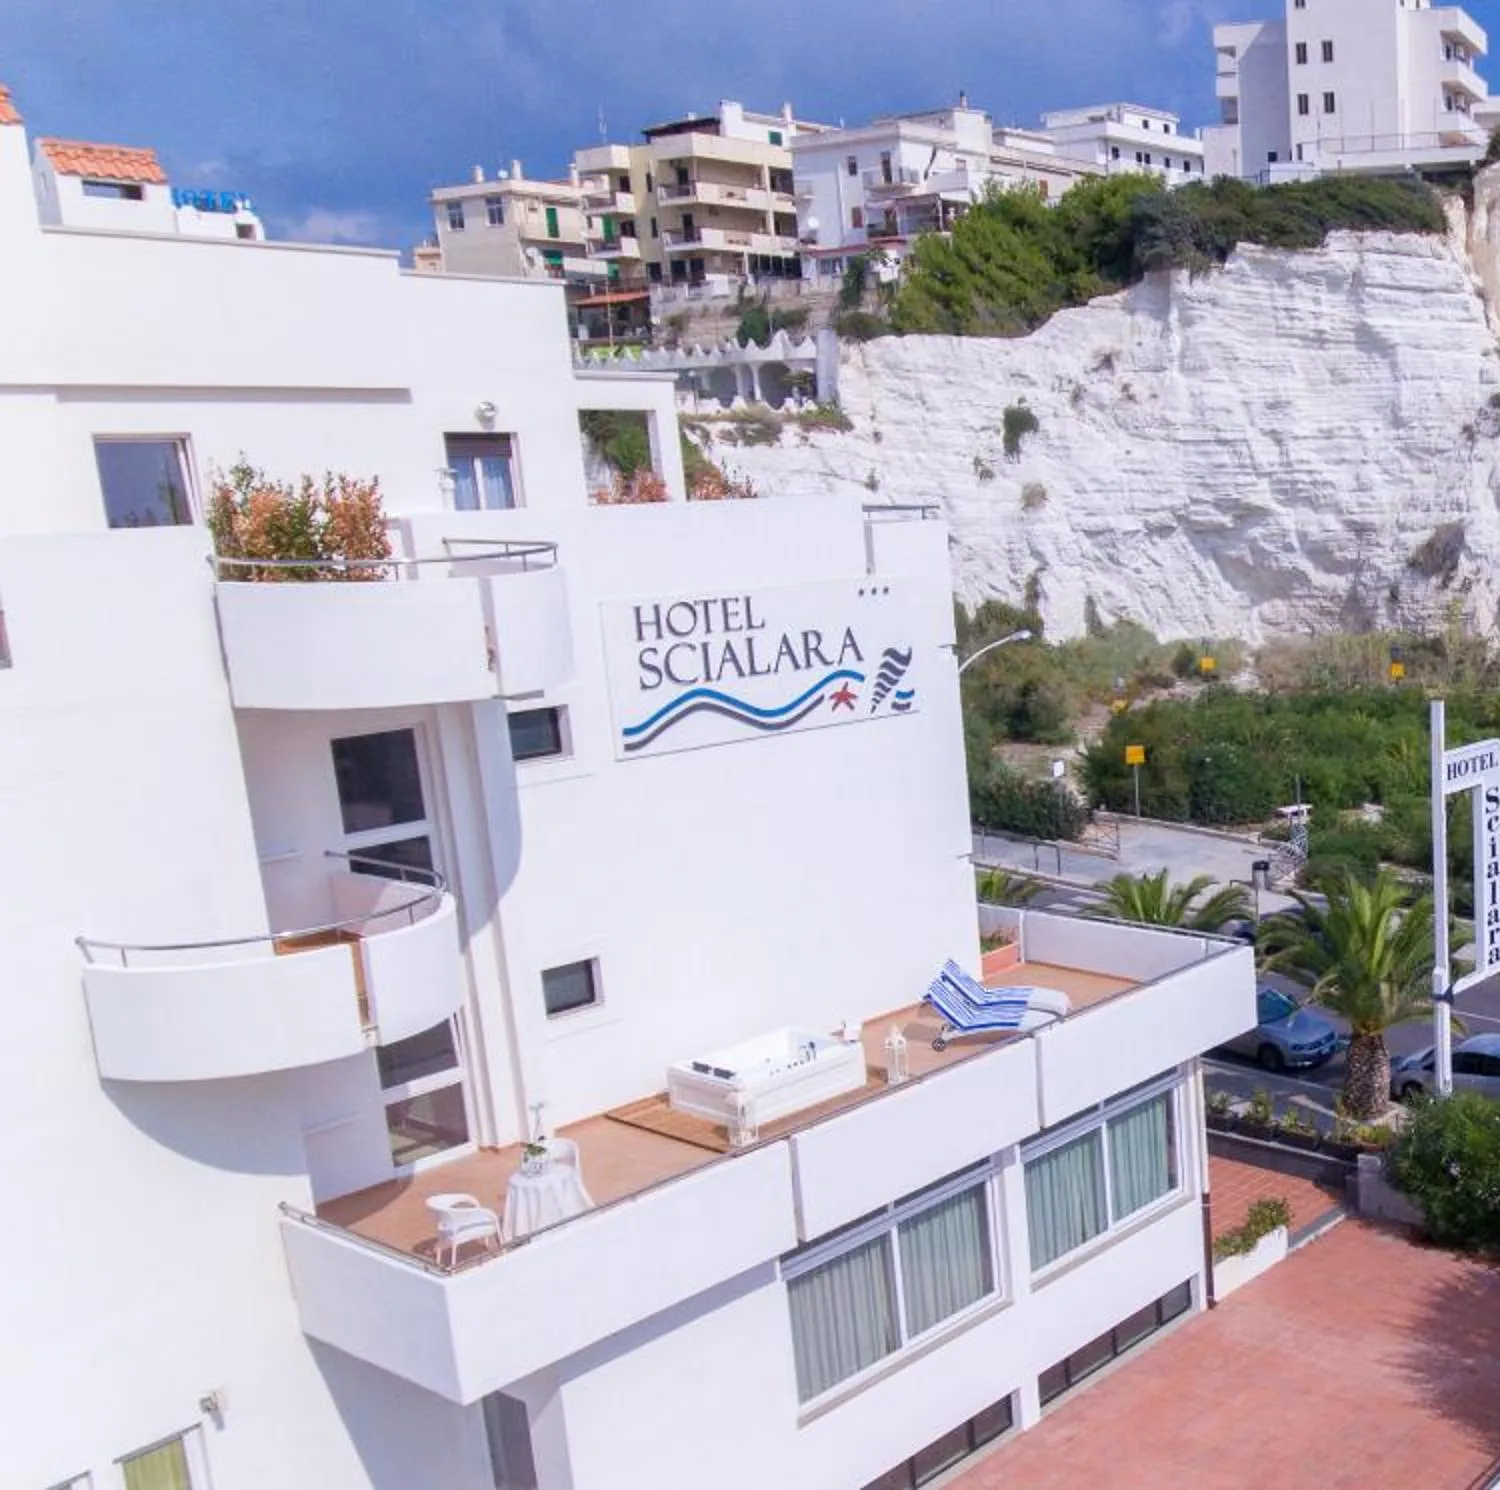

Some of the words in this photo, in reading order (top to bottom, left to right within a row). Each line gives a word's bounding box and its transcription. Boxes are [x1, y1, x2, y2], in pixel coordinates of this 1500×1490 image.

[633, 596, 766, 641] HOTEL
[638, 626, 864, 690] SCIALARA
[1447, 752, 1499, 781] HOTEL
[1484, 786, 1500, 965] Scialara
